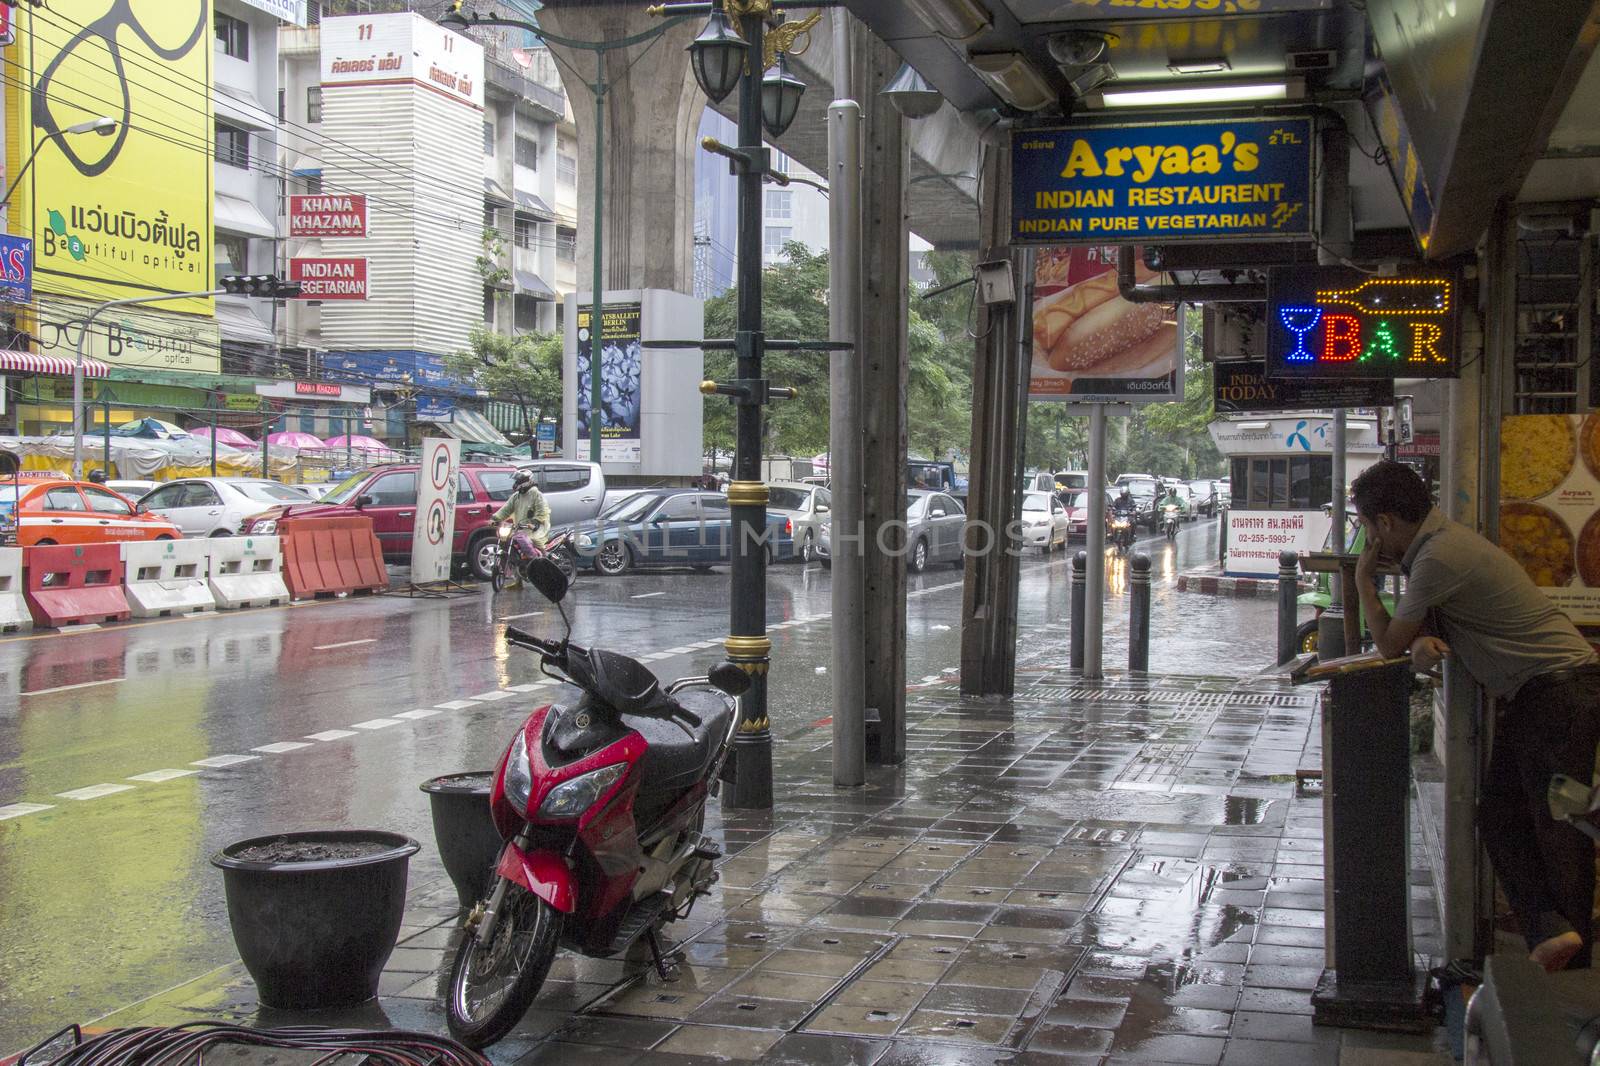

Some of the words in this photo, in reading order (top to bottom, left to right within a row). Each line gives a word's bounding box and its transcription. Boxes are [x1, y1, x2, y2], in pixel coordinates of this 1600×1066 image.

[358, 24, 373, 40] 11
[443, 34, 454, 53] 11
[1060, 131, 1259, 183] Aryaa's
[1035, 188, 1114, 209] INDIAN
[1128, 183, 1285, 207] RESTAURENT
[301, 198, 353, 212] KHANA
[292, 214, 362, 229] KHAZANA
[1019, 218, 1082, 232] INDIAN
[1089, 216, 1139, 231] PURE
[1145, 213, 1266, 229] VEGETARIAN
[71, 204, 200, 259] แว่นบิวตี้ฟูล
[44, 227, 135, 262] Beautiful
[143, 255, 201, 274] optical
[301, 263, 354, 277] INDIAN
[300, 280, 365, 294] EGETARIAN
[1321, 315, 1447, 362] BAR
[1218, 385, 1279, 401] TODAY
[1238, 534, 1296, 543] 02-255-5993-7
